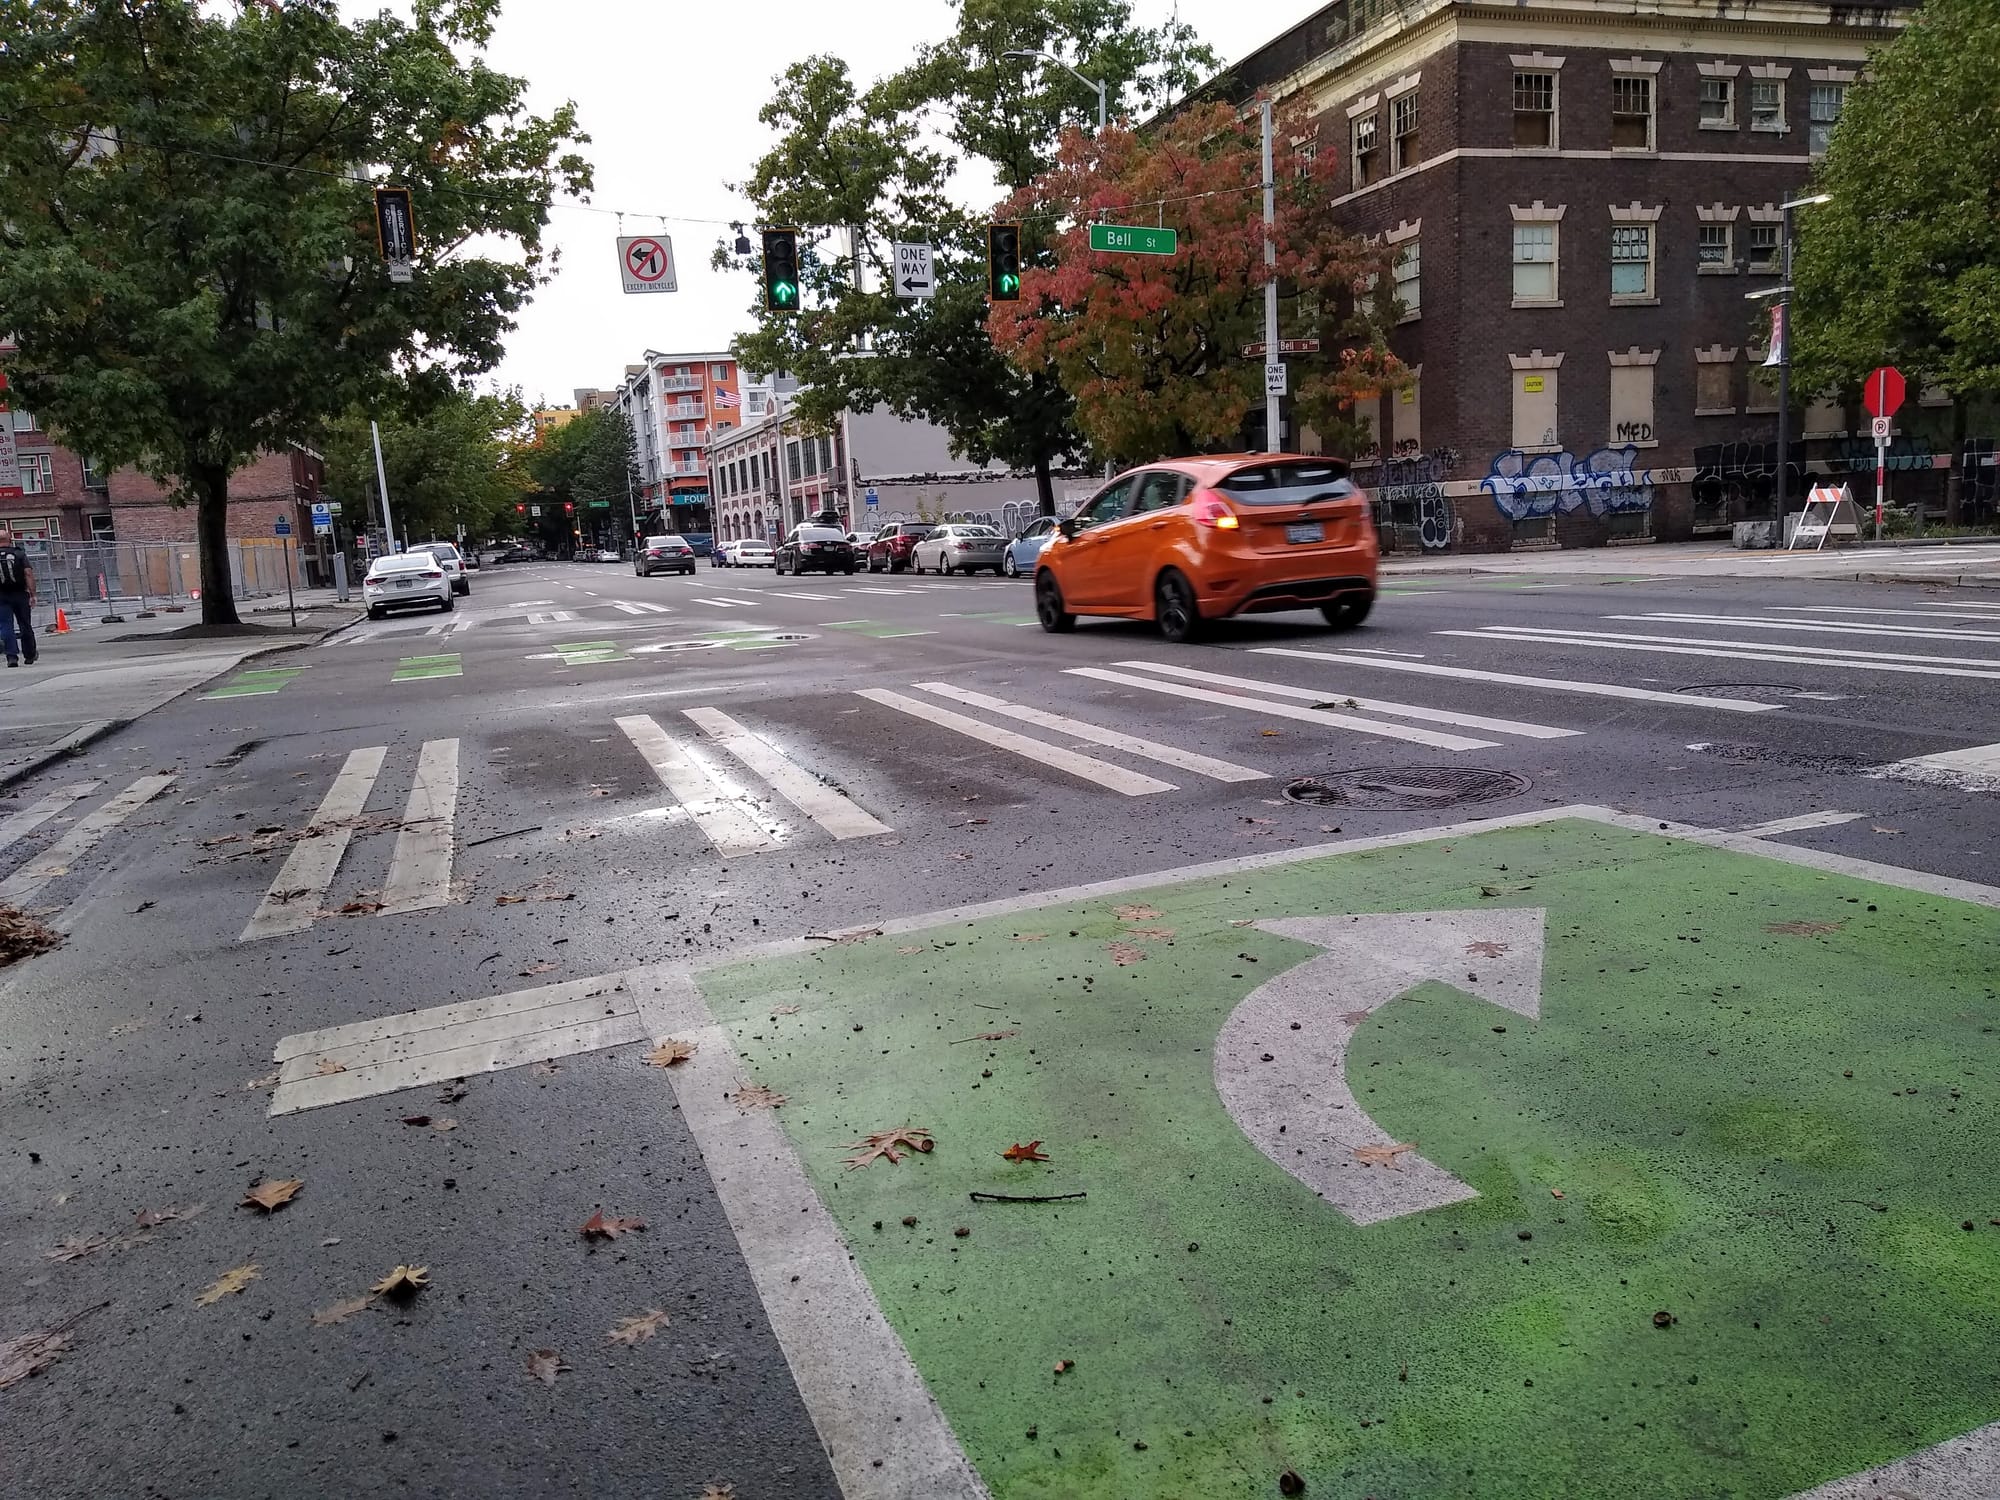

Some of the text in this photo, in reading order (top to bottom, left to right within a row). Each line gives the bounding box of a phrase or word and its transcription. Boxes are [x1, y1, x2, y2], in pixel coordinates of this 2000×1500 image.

[1107, 231, 1156, 248] Bell St
[901, 248, 926, 260] ONE
[901, 262, 927, 275] WAY
[626, 281, 675, 291] EXCEPT BICYCLES
[1280, 341, 1294, 350] Bell
[1267, 366, 1284, 374] ONE
